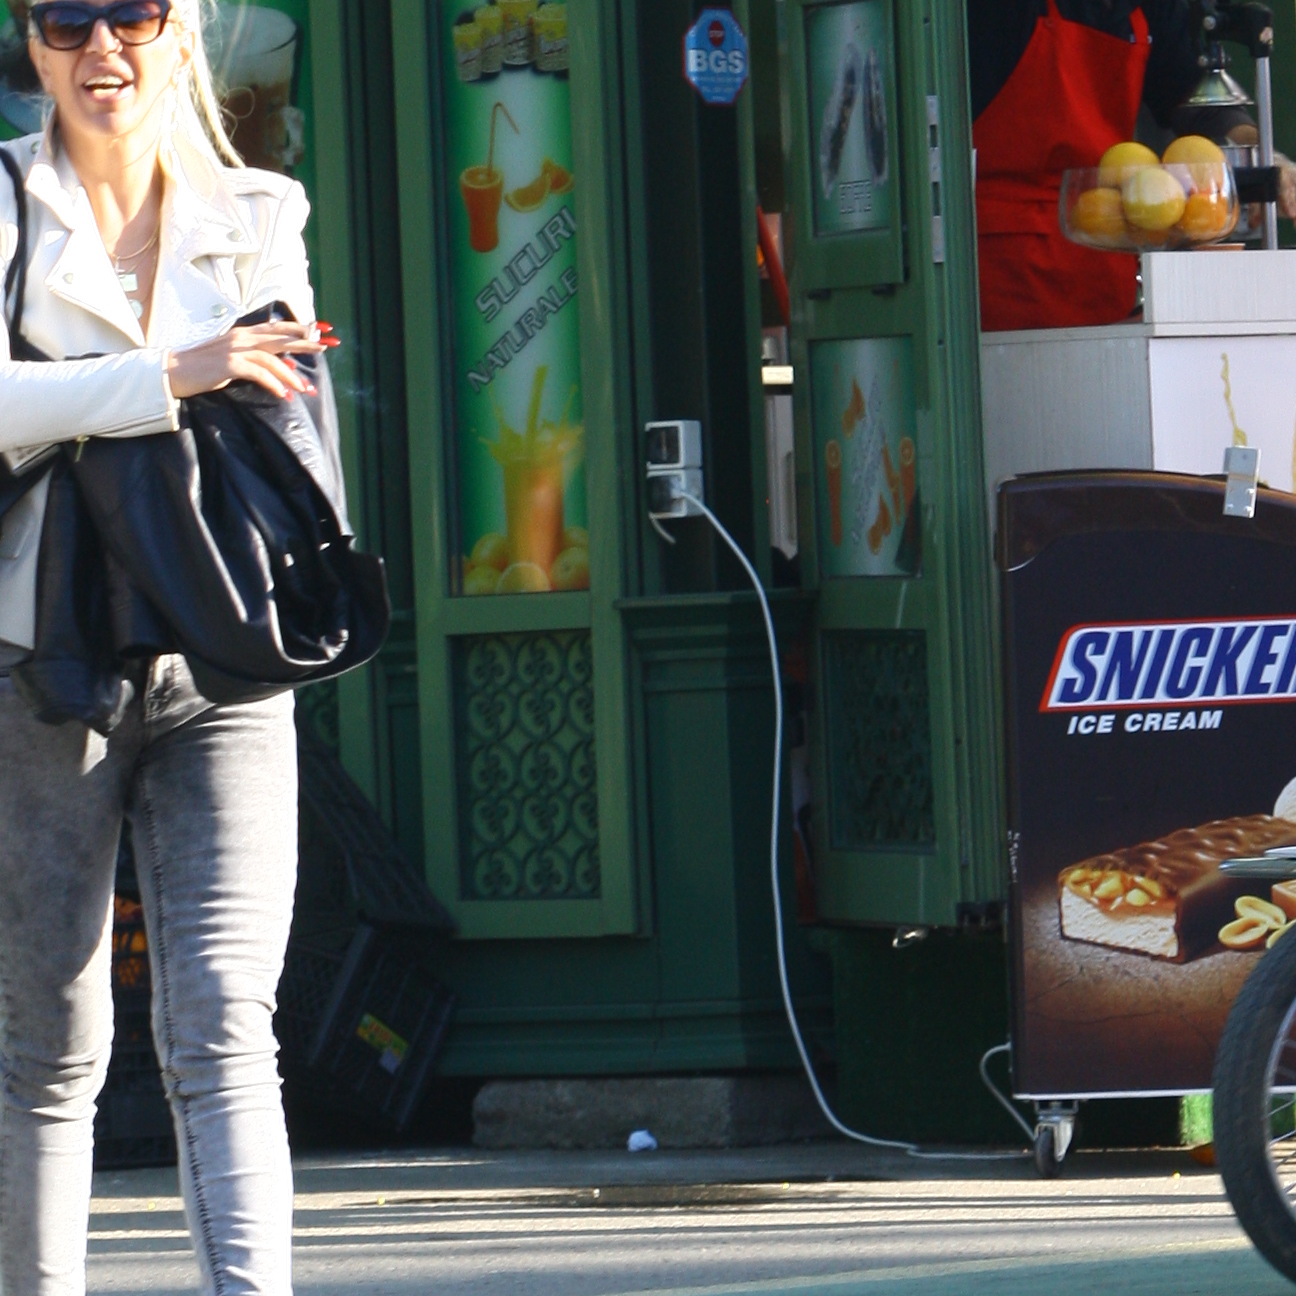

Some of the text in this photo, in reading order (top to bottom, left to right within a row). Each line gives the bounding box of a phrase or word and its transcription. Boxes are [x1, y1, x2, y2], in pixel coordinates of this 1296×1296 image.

[688, 49, 744, 74] BGS
[475, 206, 577, 323] SUCURI
[466, 265, 578, 394] NATURALE
[1067, 710, 1223, 735] ICE CREAM
